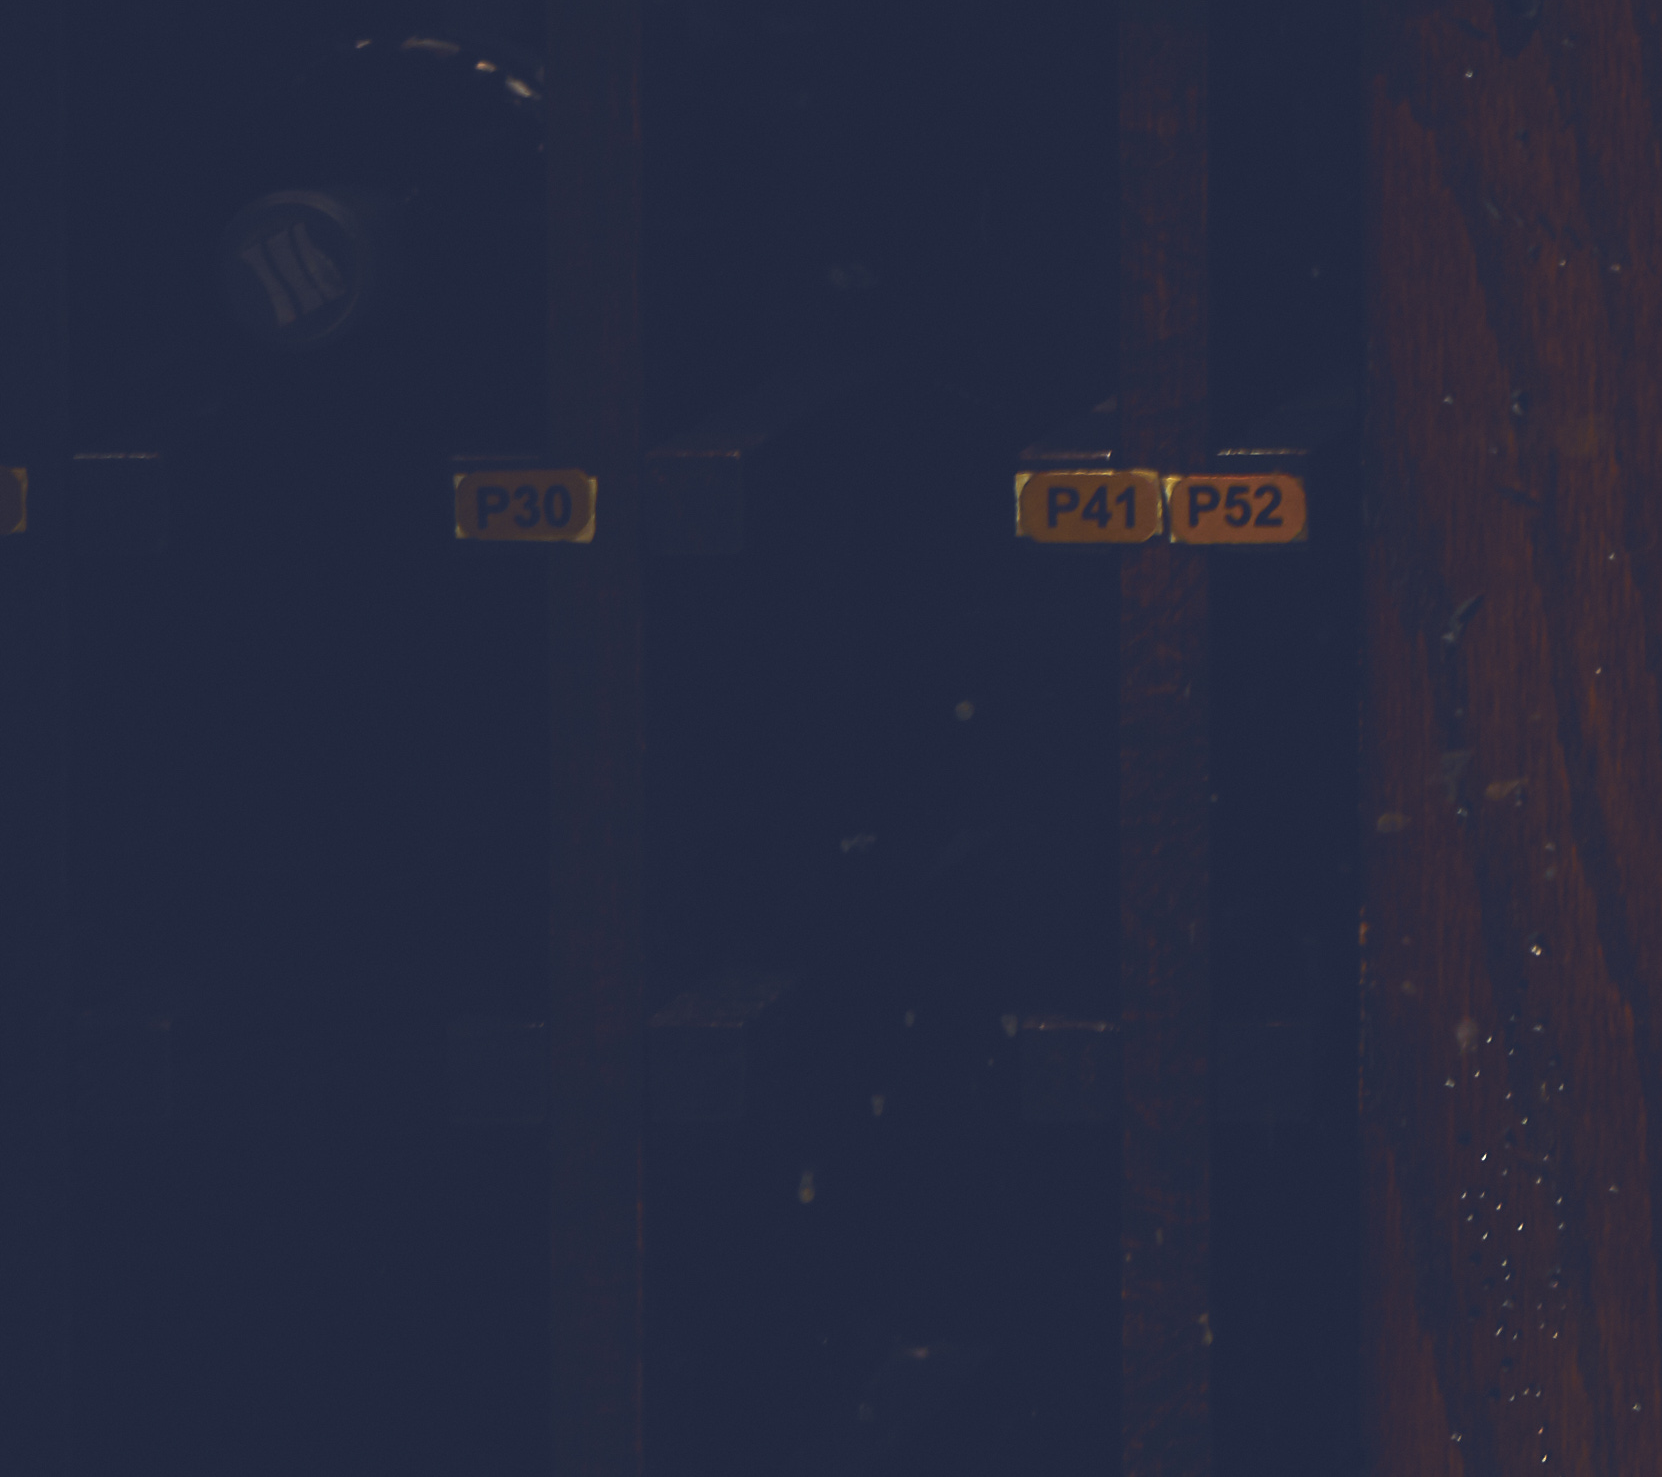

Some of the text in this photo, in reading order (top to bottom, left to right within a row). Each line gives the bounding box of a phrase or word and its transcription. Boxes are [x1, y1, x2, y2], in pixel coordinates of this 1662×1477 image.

[476, 485, 572, 529] P30
[1048, 486, 1135, 528] P41
[1189, 485, 1283, 527] P52
